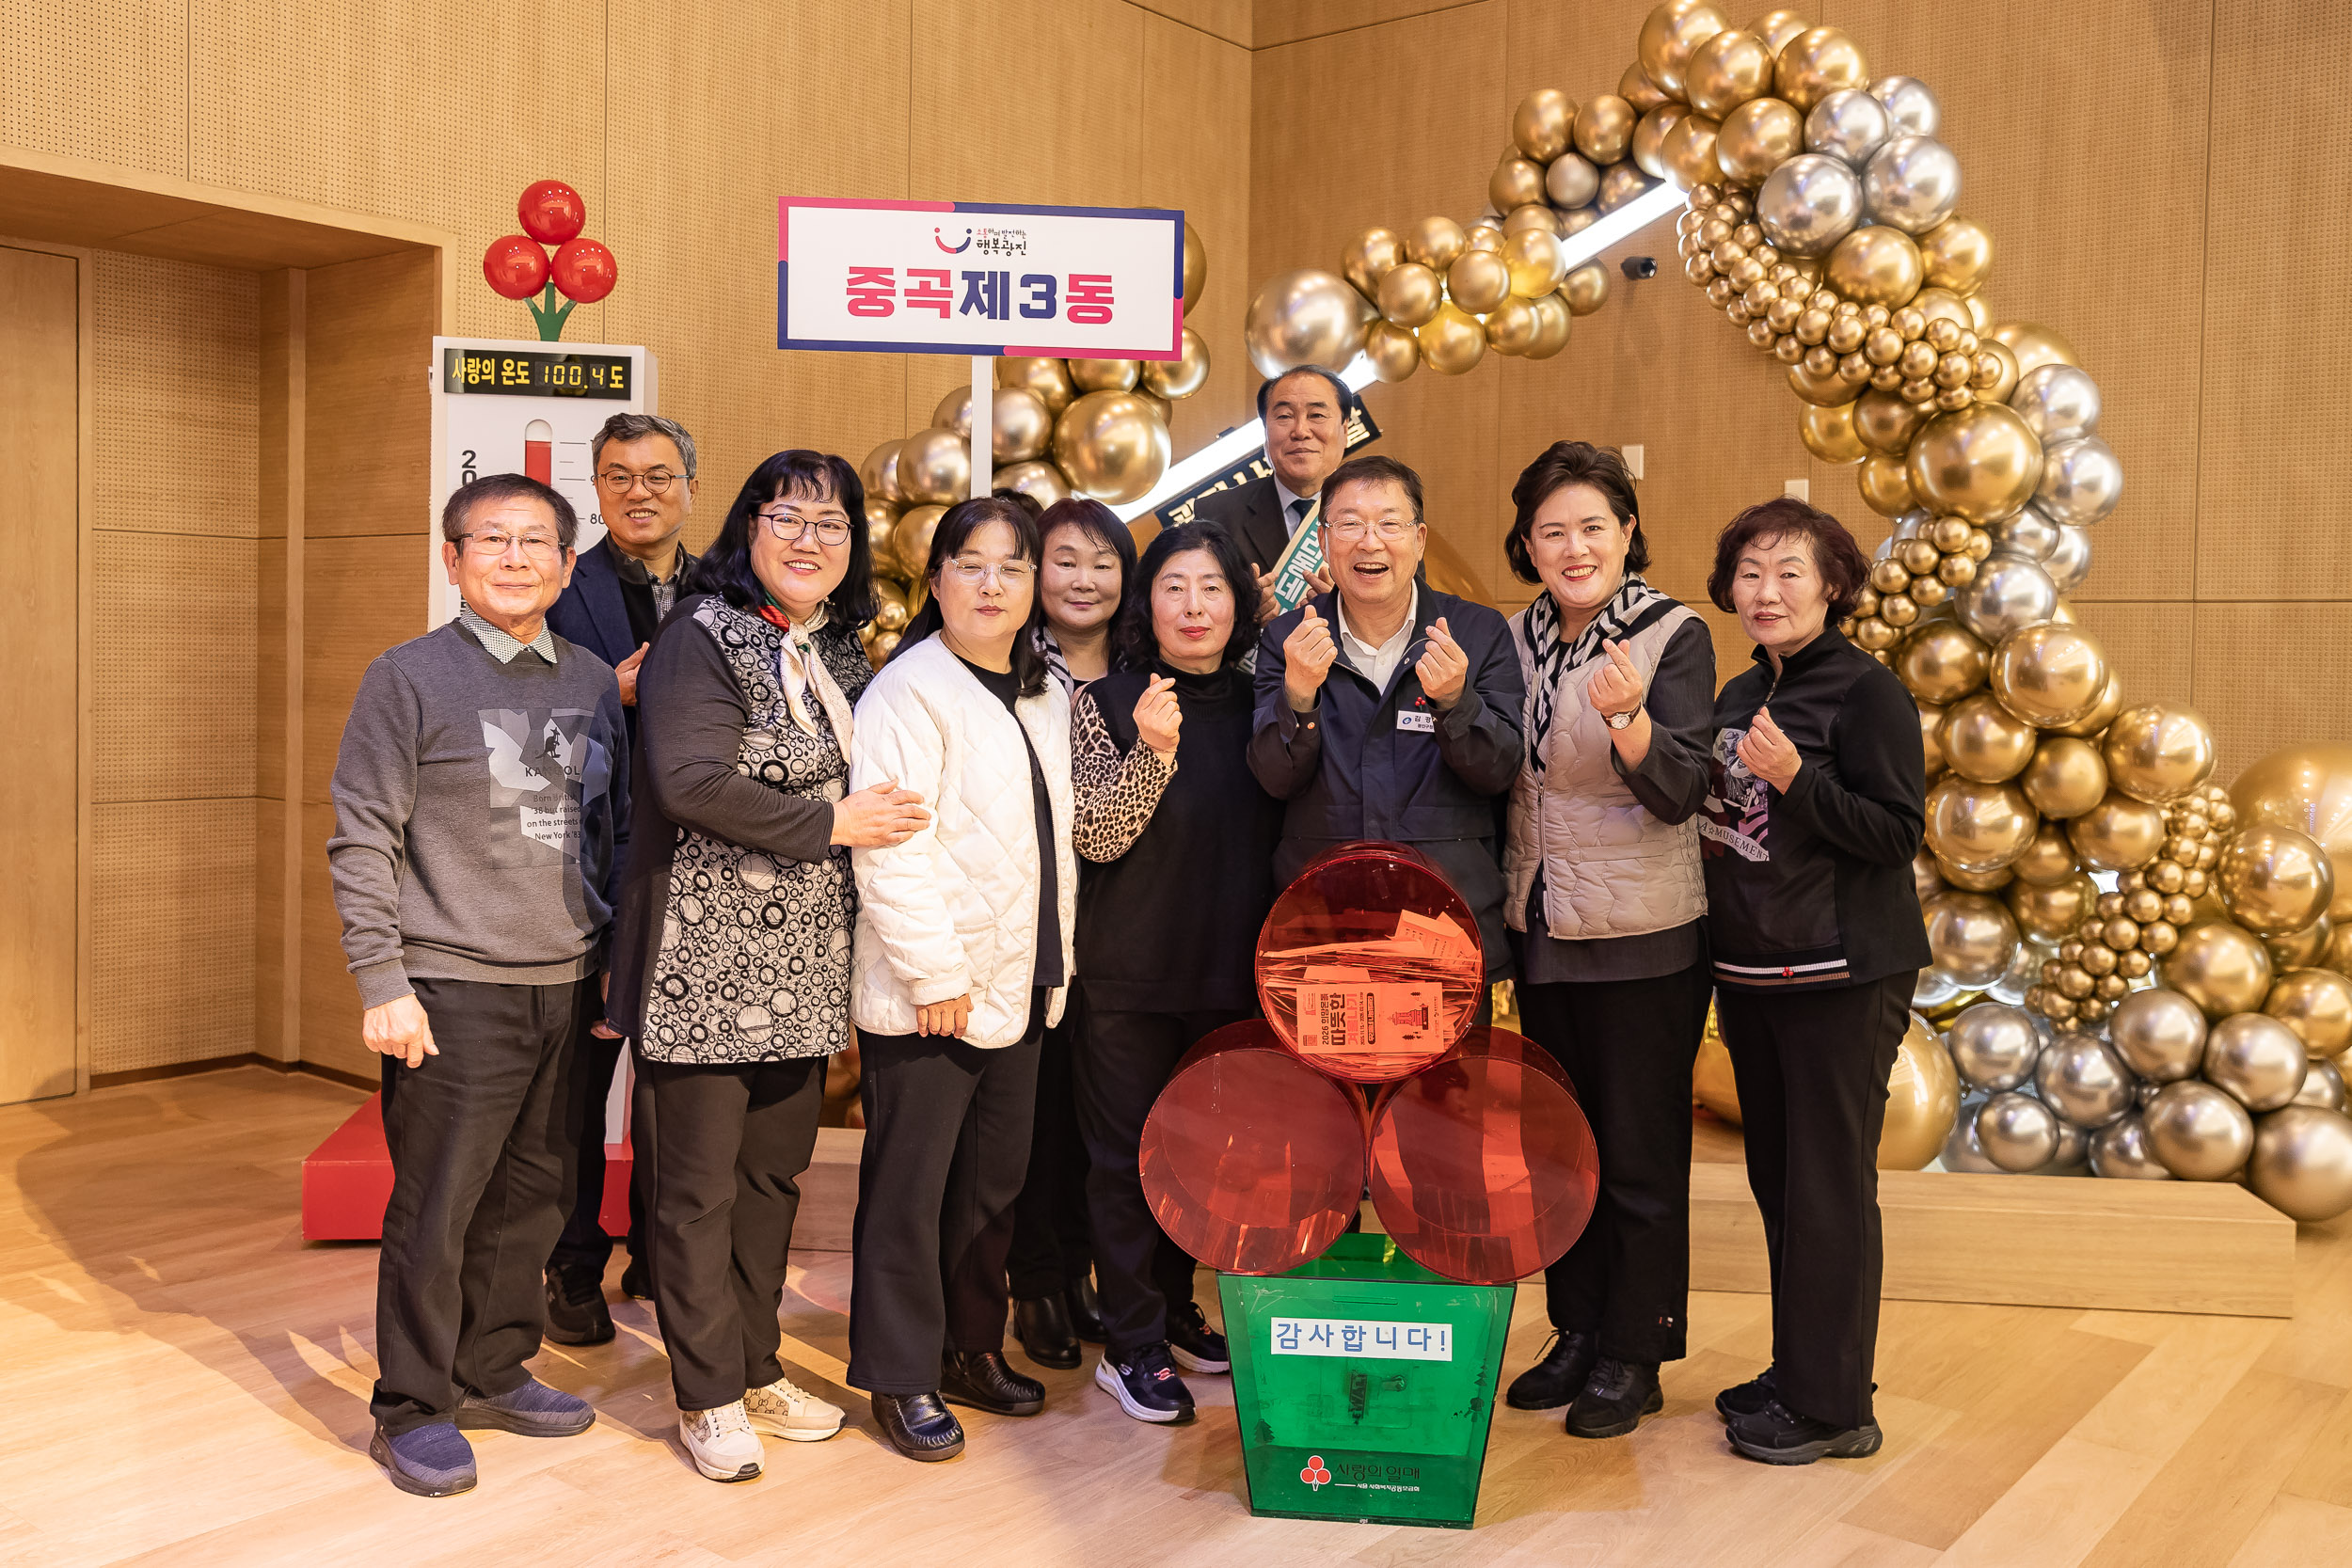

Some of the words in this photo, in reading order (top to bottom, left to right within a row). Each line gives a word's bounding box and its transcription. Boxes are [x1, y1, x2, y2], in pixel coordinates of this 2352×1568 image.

[977, 238, 1026, 256] 행복광진
[846, 265, 1115, 325] 중곡제3동
[452, 356, 495, 386] 사랑의
[501, 358, 530, 386] 온도
[544, 365, 604, 389] 100.4
[609, 365, 625, 389] 도
[545, 806, 558, 815] but
[559, 805, 581, 814] raised
[538, 818, 552, 827] the
[553, 817, 579, 826] streets
[553, 831, 571, 839] York
[1329, 992, 1346, 1046] 따뜻한
[1344, 993, 1359, 1045] 겨울나기
[1321, 1025, 1329, 1045] 2026
[1276, 1323, 1446, 1353] 감사합니다!
[1335, 1464, 1382, 1481] 사랑의
